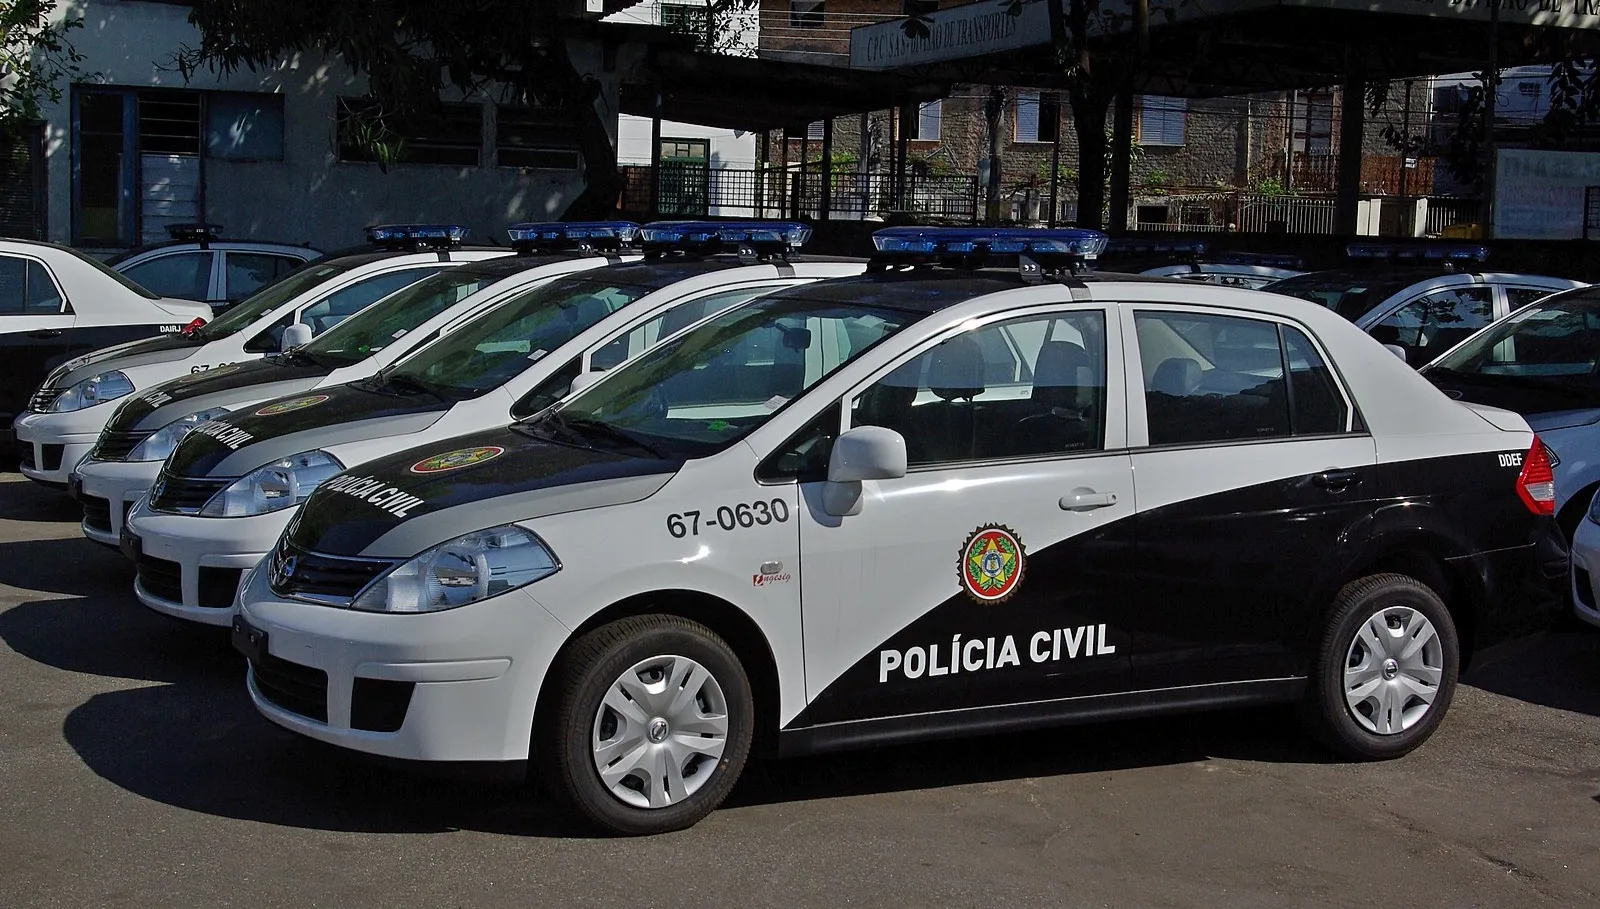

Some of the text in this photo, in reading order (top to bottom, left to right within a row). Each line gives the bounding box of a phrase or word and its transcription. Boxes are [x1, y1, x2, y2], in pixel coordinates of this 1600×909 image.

[1498, 453, 1523, 468] DDEF
[367, 486, 426, 518] CIVIL
[666, 497, 789, 538] 67-0630
[879, 622, 1116, 683] POLÍCIA CIVIL
